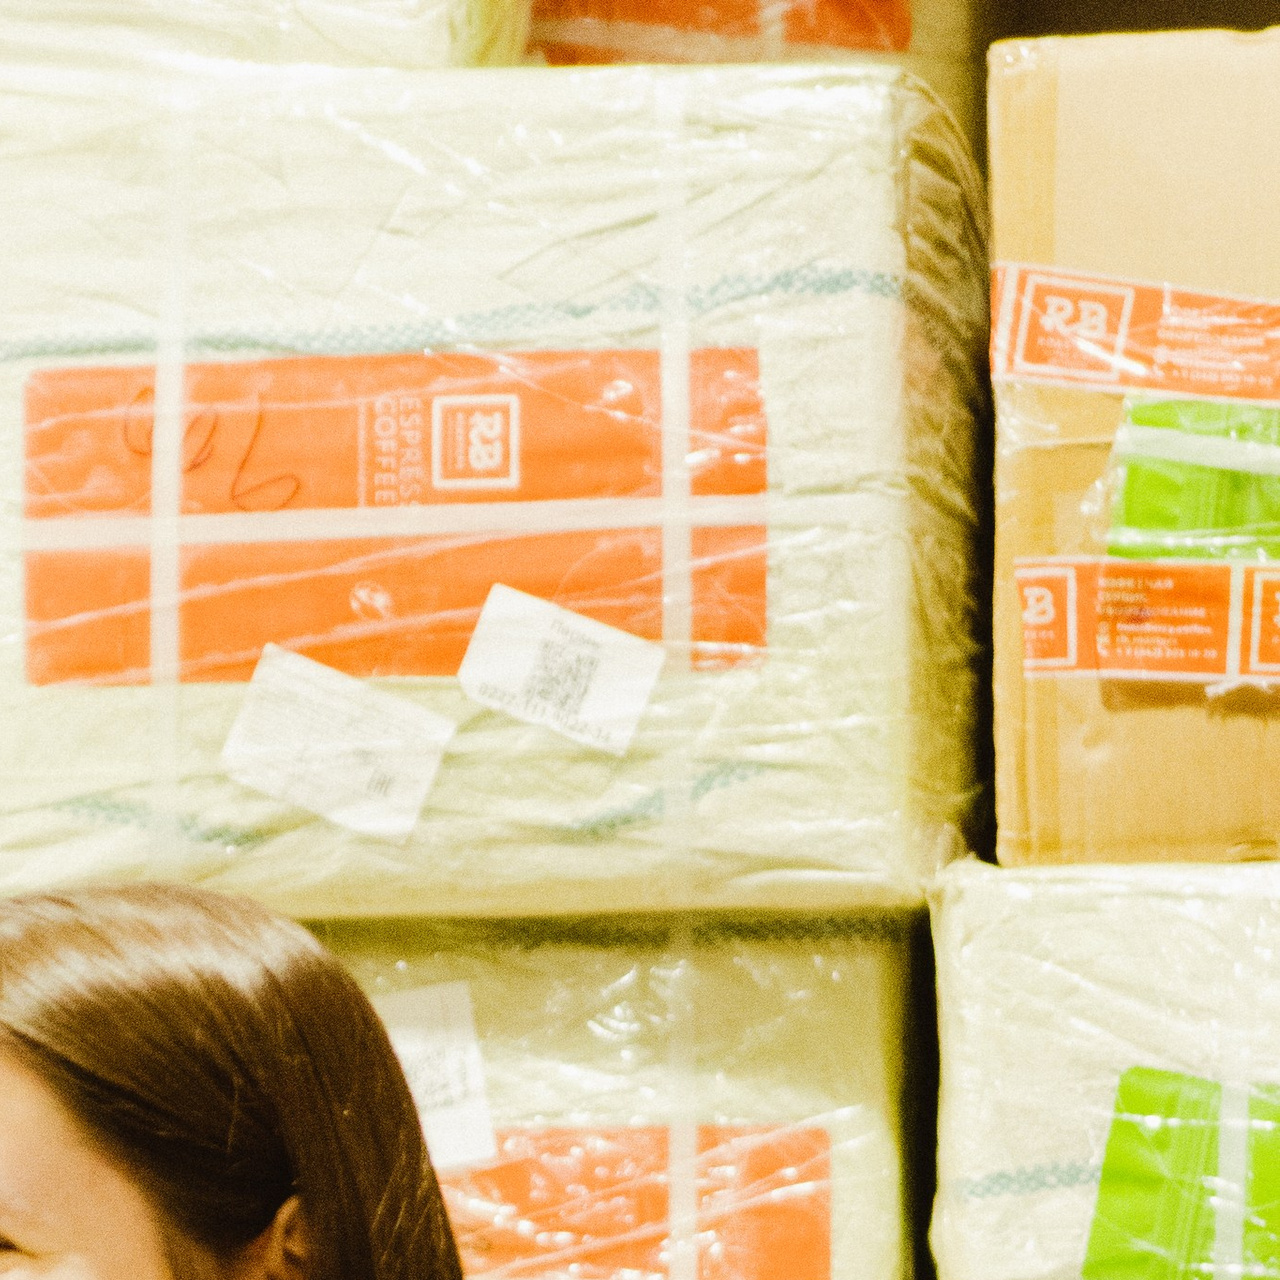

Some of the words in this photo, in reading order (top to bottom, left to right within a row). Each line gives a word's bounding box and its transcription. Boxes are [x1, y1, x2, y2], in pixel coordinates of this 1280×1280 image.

[1040, 294, 1108, 337] RB
[373, 396, 398, 504] COFFEE
[399, 396, 423, 506] ESPRES
[468, 411, 504, 471] RB
[1023, 586, 1055, 624] B
